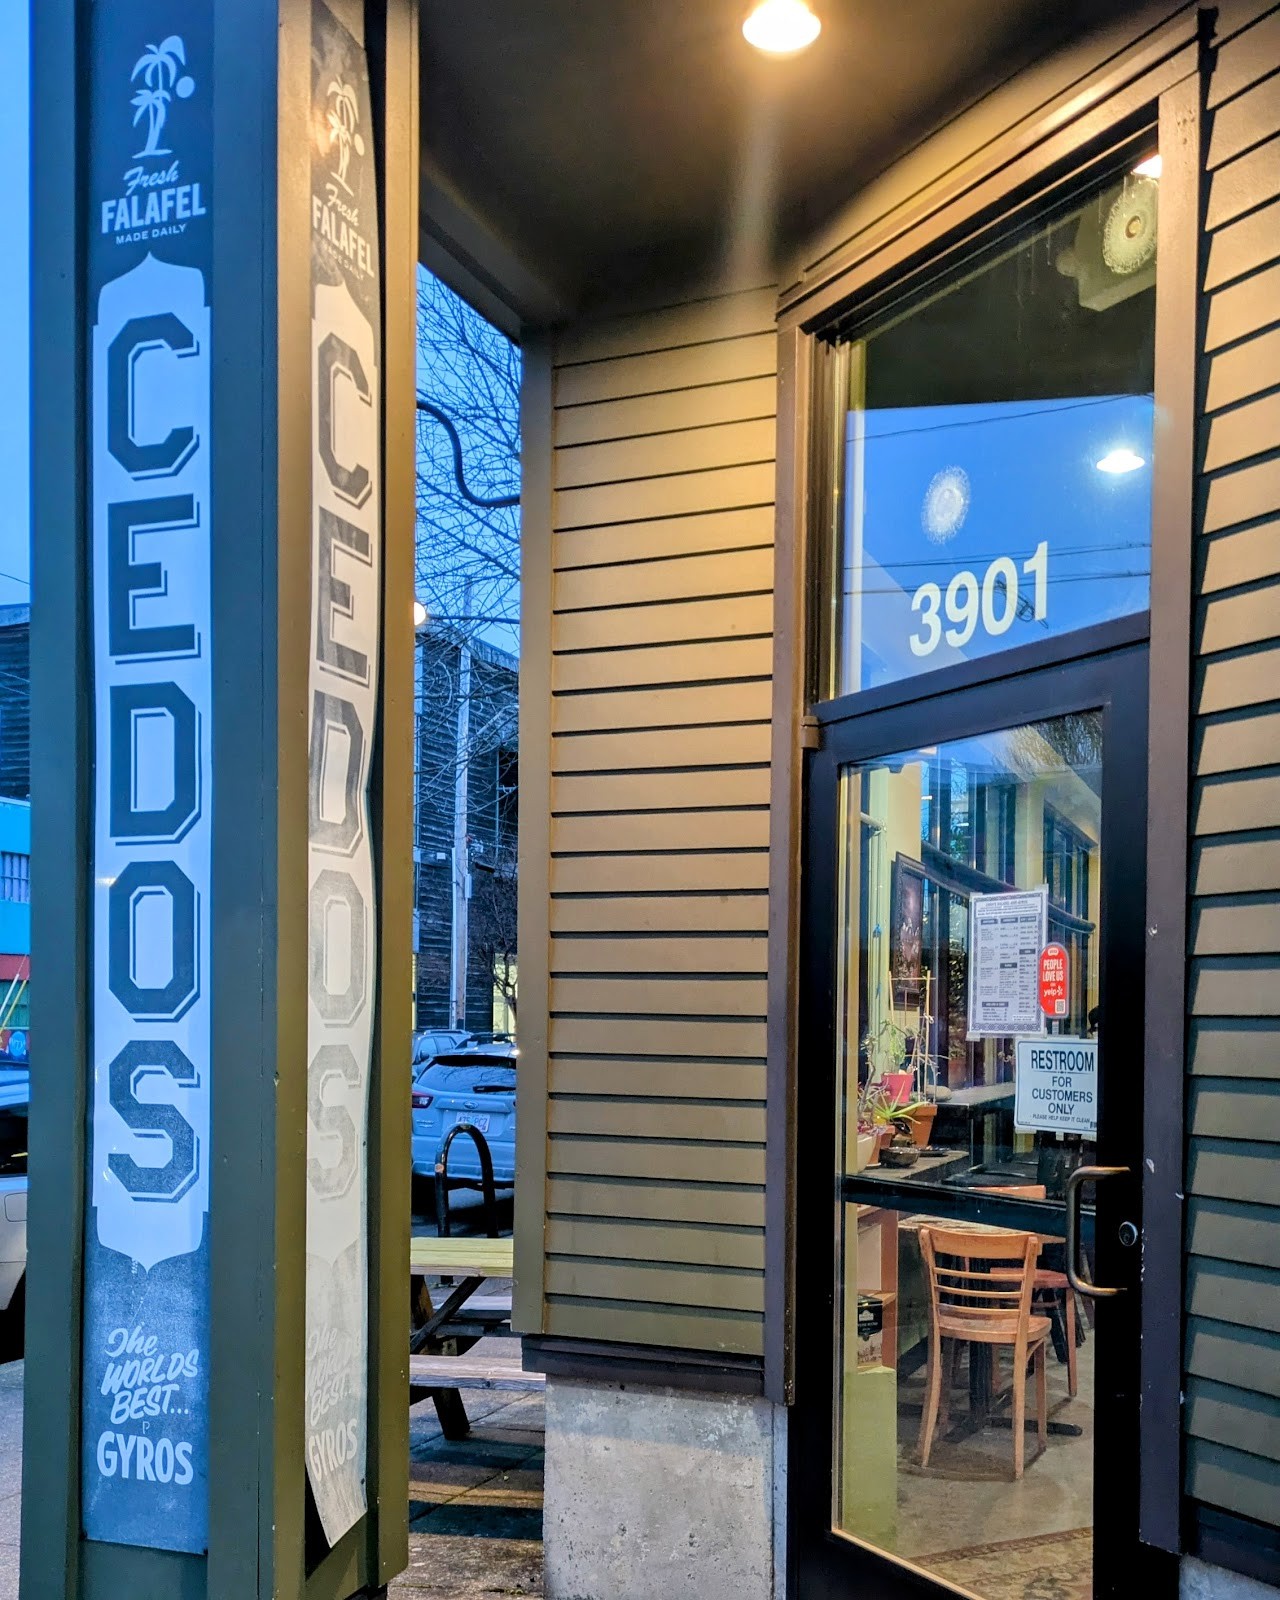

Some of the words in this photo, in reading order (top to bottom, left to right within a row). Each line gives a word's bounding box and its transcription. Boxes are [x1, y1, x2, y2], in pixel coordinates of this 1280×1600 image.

[123, 160, 180, 196] Fresh
[101, 183, 206, 234] FALAFEL
[325, 182, 359, 227] Fresh
[116, 230, 149, 245] MADE
[152, 223, 187, 238] DAILY
[312, 194, 375, 278] FALAFEL
[910, 541, 1048, 657] 3901
[107, 312, 201, 1203] CEDOS
[307, 332, 372, 1203] CEDOS
[1042, 970, 1056, 982] LOVE
[1056, 970, 1064, 981] US
[1043, 958, 1063, 970] PEOPLE
[1043, 987, 1058, 997] yelp
[1031, 1050, 1094, 1072] RESTROOM
[1032, 1088, 1093, 1103] CUSTOMERS
[1052, 1076, 1072, 1088] FOR
[1048, 1102, 1074, 1115] ONLY
[104, 1322, 158, 1358] The
[101, 1349, 199, 1396] WORLDS
[97, 1431, 194, 1485] GYROS
[308, 1418, 358, 1481] GYROS
